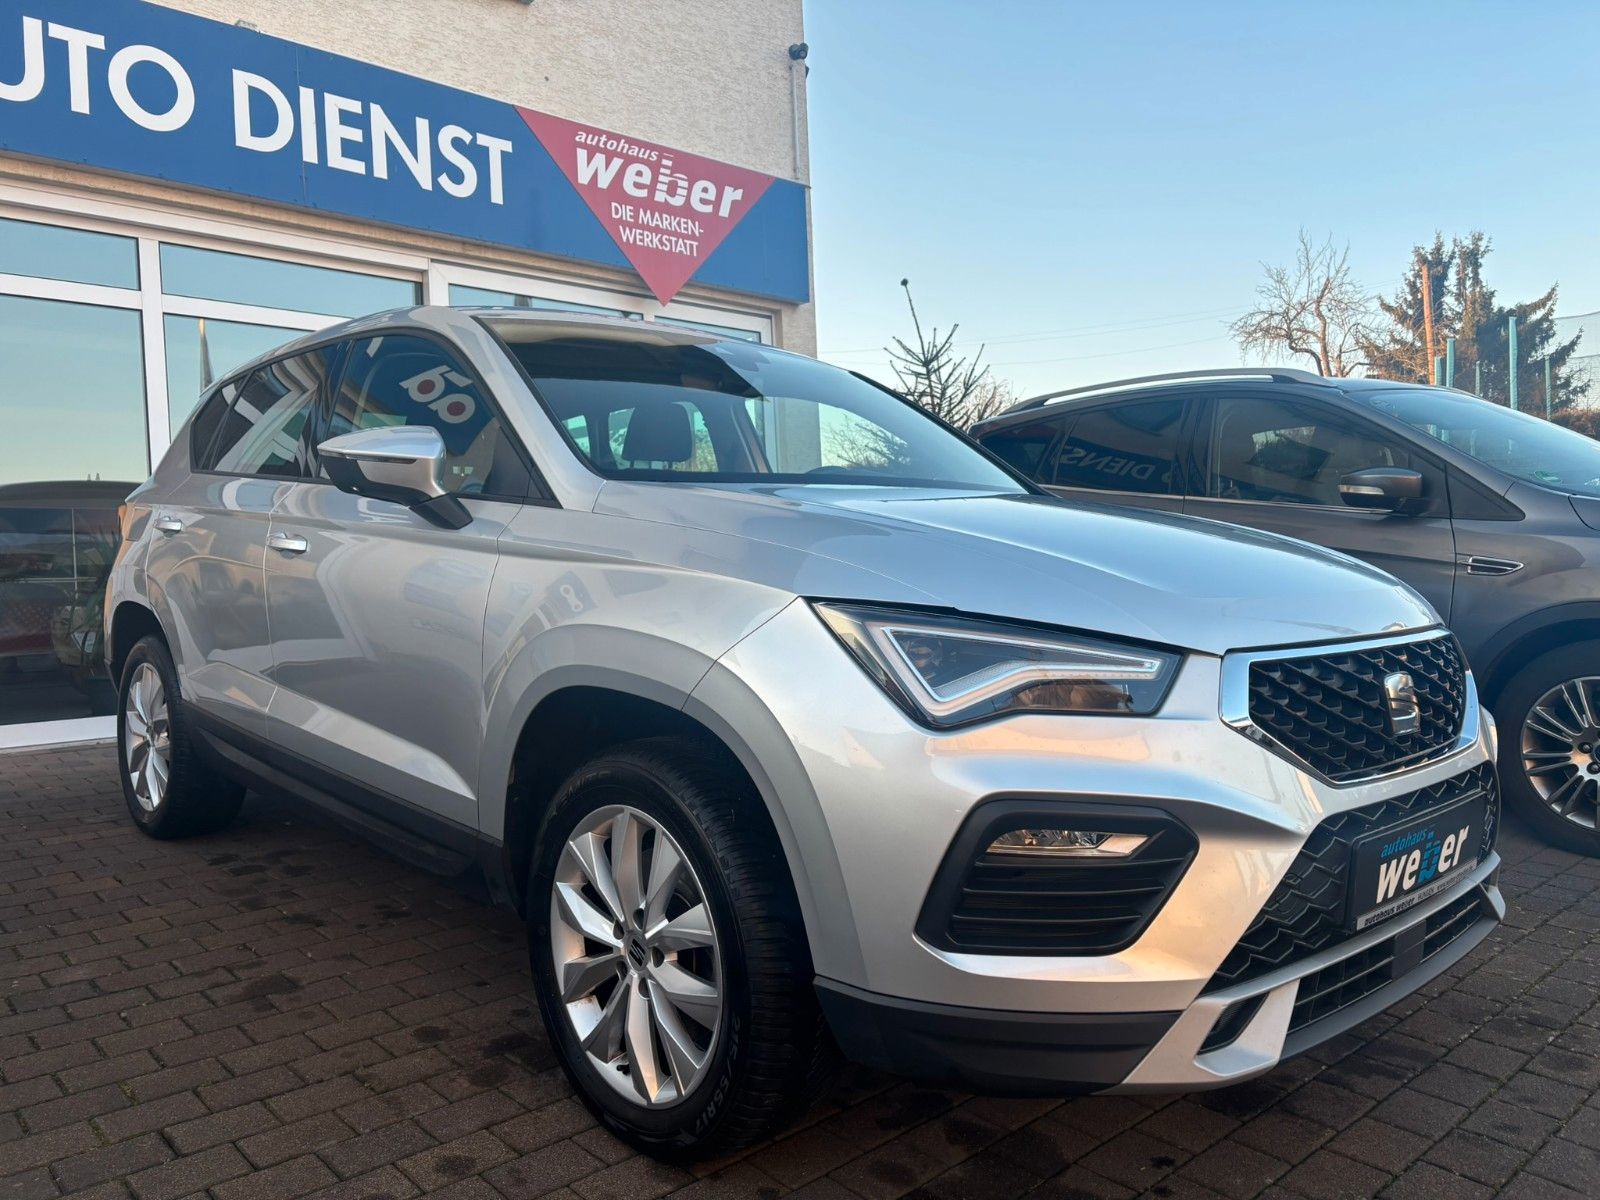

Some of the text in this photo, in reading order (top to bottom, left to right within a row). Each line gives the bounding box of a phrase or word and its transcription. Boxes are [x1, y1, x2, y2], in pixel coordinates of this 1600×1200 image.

[232, 69, 513, 205] DIENST
[575, 131, 659, 161] autohaus
[576, 147, 744, 218] weber
[611, 202, 704, 237] DIE MARKEN-
[619, 225, 699, 257] WERKSTATT
[1381, 828, 1428, 858] autohaus
[1376, 825, 1470, 904] weber
